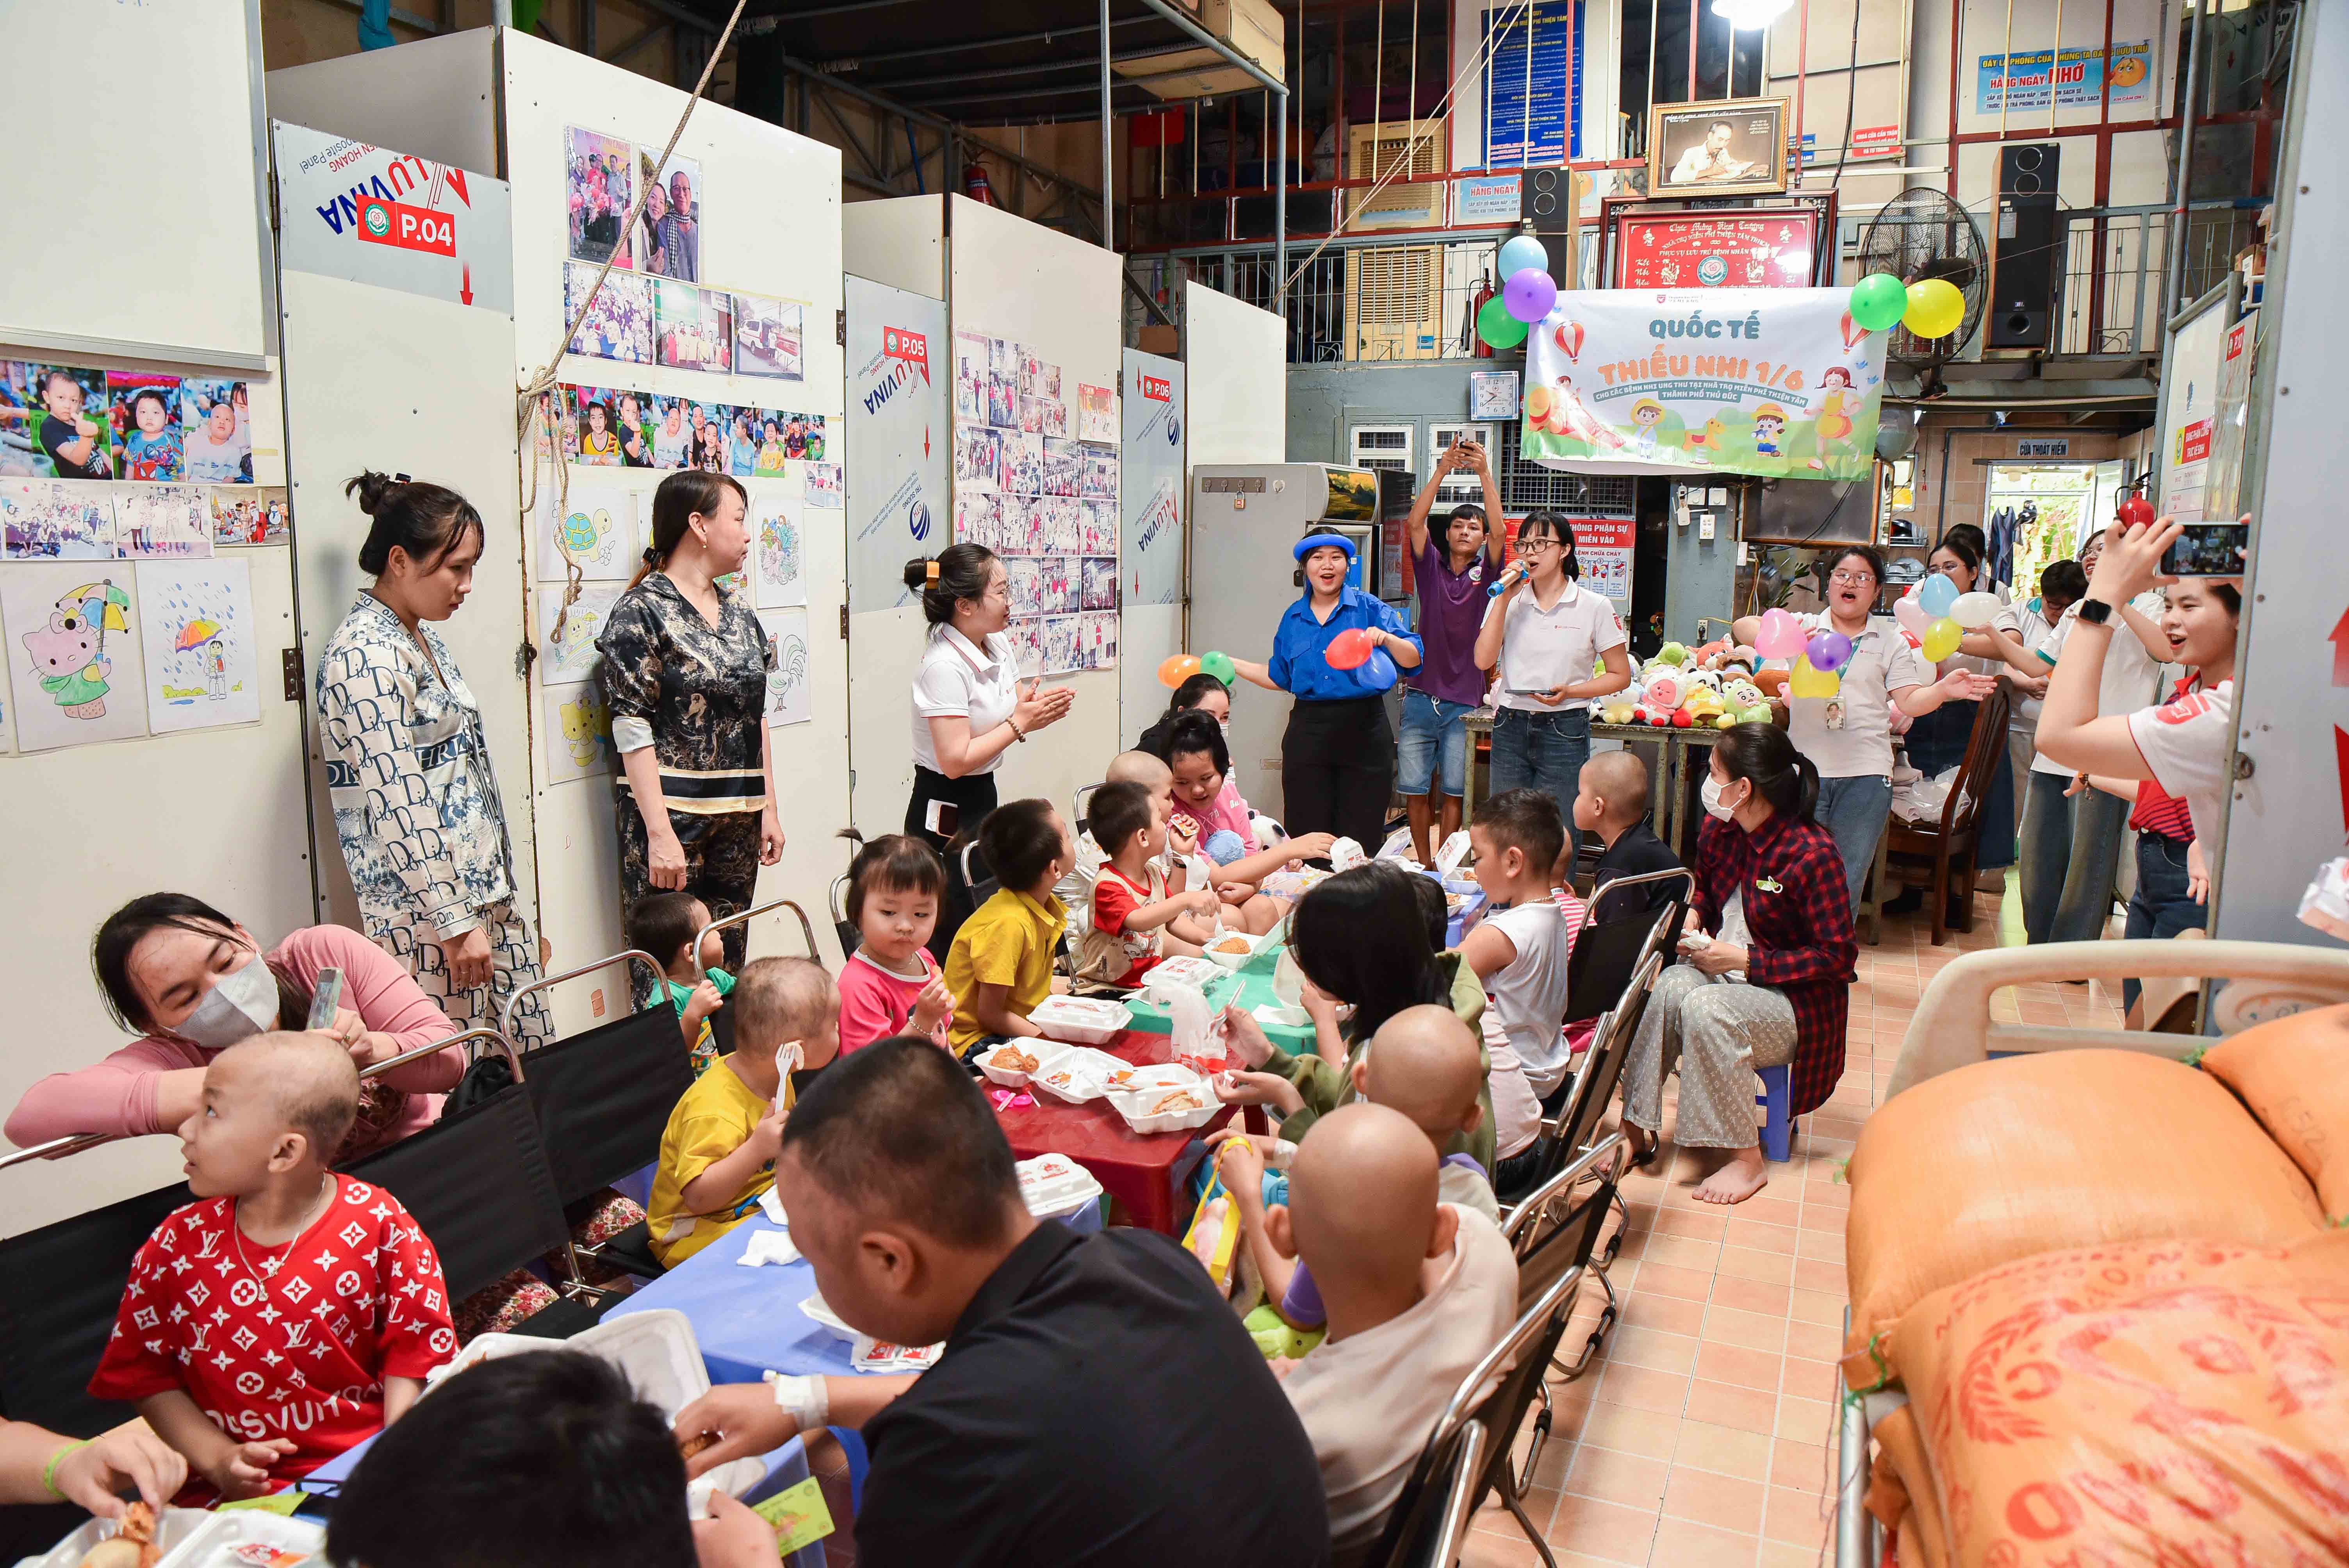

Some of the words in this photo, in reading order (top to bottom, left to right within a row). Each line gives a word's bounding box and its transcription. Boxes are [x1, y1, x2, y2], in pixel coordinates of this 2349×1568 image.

[2059, 52, 2080, 61] HÚNG
[325, 138, 356, 157] posite
[299, 151, 326, 174] Panel
[329, 147, 362, 172] HOANG
[401, 213, 453, 246] P.04
[1649, 310, 1722, 339] QUỐC
[1727, 310, 1760, 340] TẾ
[902, 337, 925, 356] P.05
[1597, 344, 1689, 386] THIẾU
[1695, 355, 1749, 380] NHI
[1755, 362, 1804, 390] 1/6
[1155, 382, 1169, 397] P.06
[1624, 384, 1643, 394] BỆNH
[1719, 383, 1733, 391] TRỌ
[1768, 391, 1790, 402] THIỆN
[1791, 396, 1806, 406] TÂM
[1662, 390, 1688, 398] THÀNH
[1688, 389, 1704, 398] PHỐ
[1722, 391, 1738, 401] ĐỨC
[2020, 442, 2031, 456] CỬA
[2032, 443, 2050, 455] THOÁT
[2051, 440, 2066, 455] HIỂM
[1594, 523, 1615, 534] PHẬN
[1617, 524, 1629, 534] SỰ
[1578, 534, 1598, 543] MIỄN
[1600, 535, 1615, 544] VÀO
